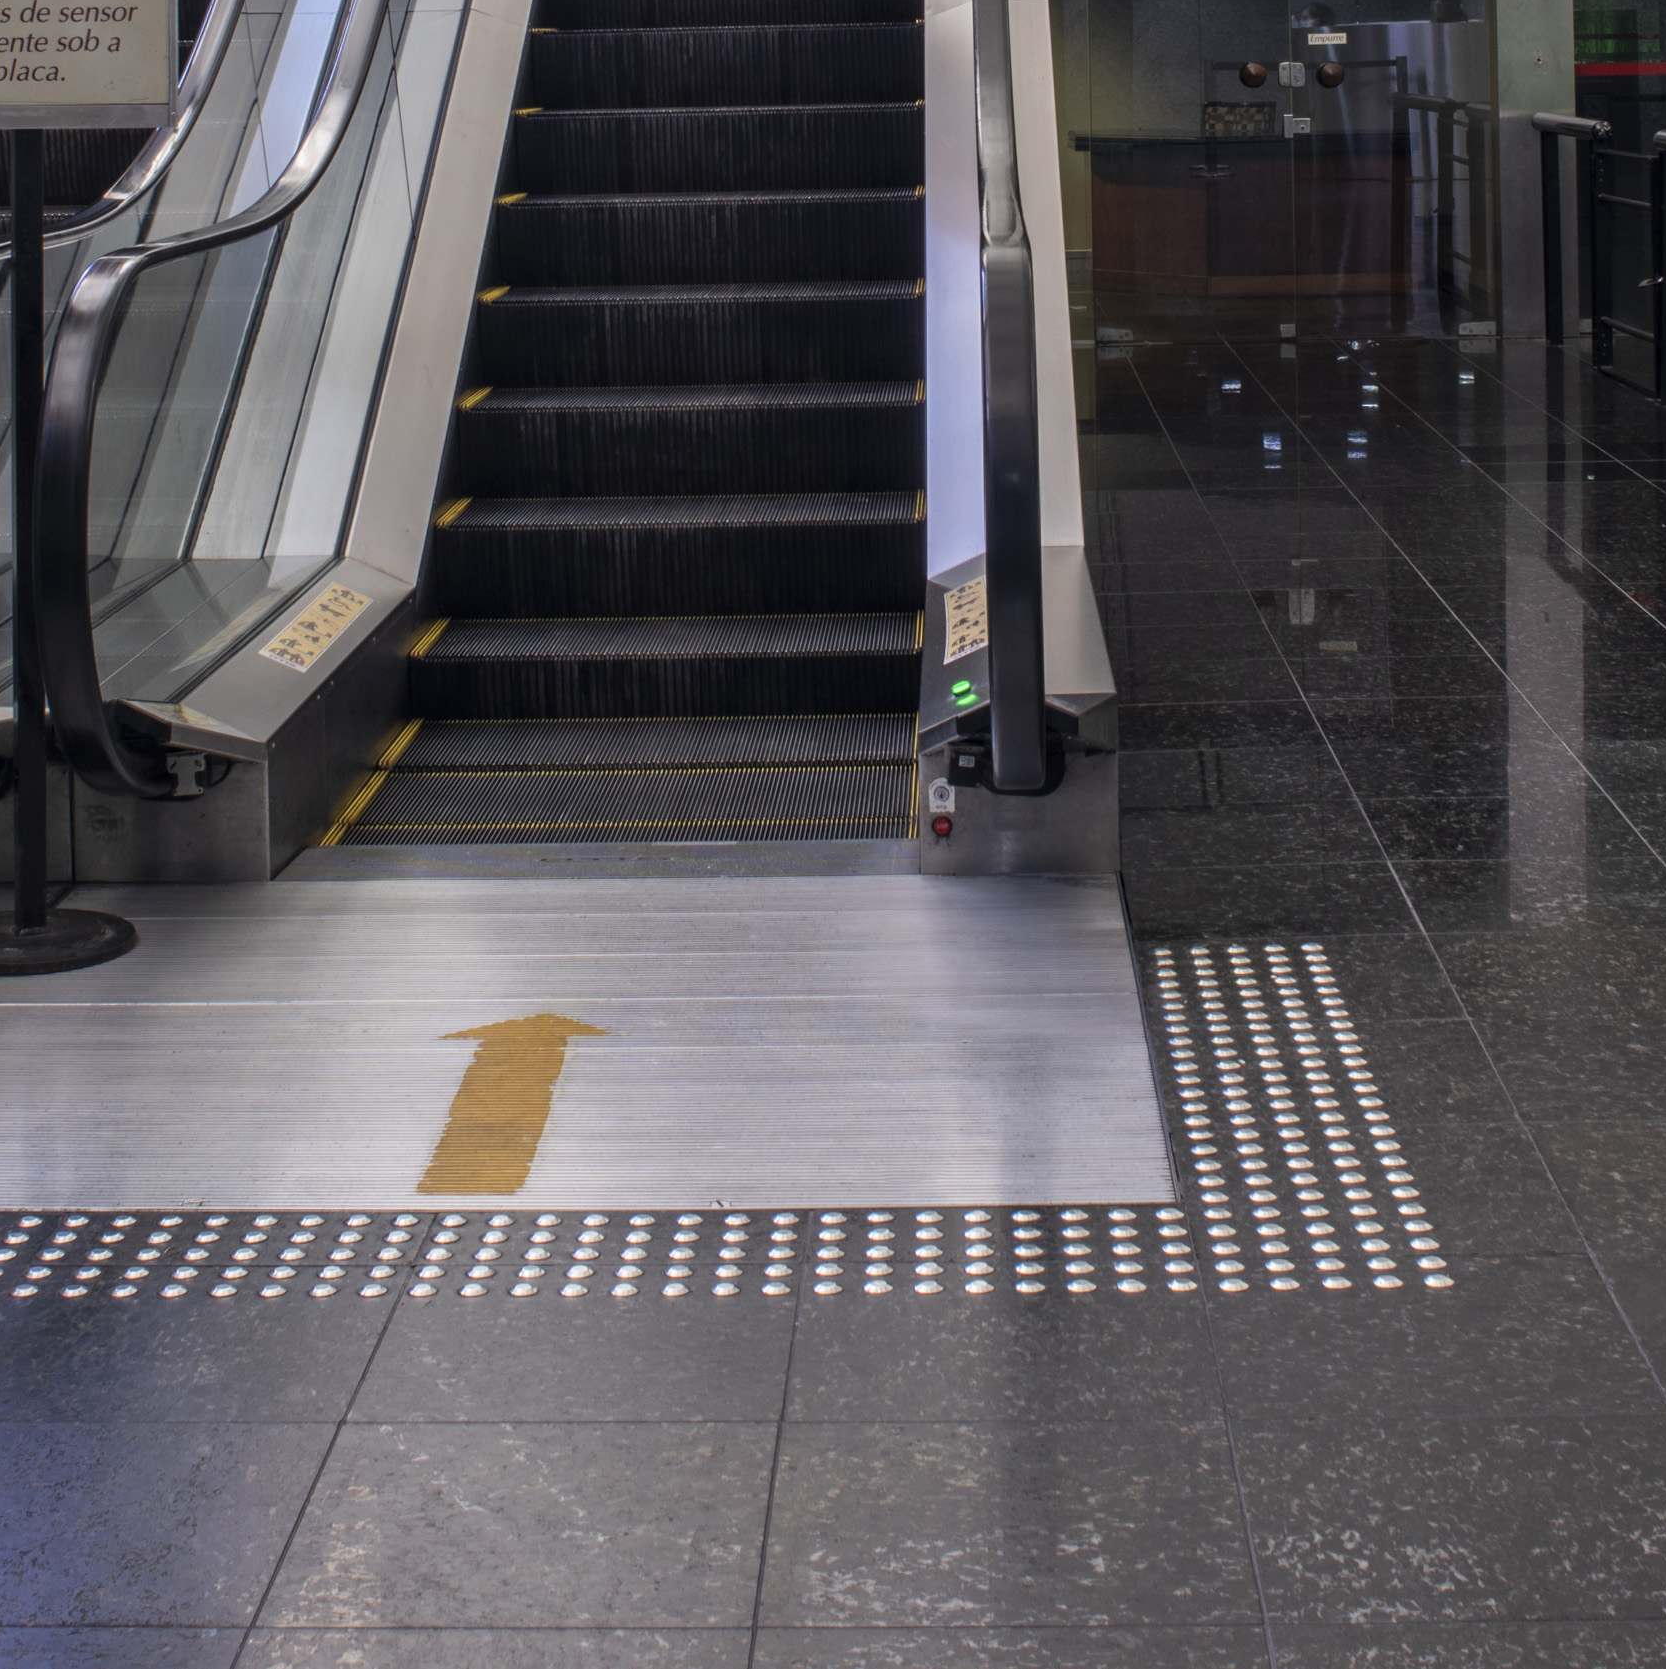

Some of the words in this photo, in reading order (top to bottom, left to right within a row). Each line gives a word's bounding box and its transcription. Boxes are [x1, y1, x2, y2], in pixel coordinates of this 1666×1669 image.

[19, 0, 51, 24] de
[58, 4, 138, 23] sensor
[56, 29, 100, 53] sob
[107, 36, 121, 53] a
[1310, 34, 1345, 44] Empurre
